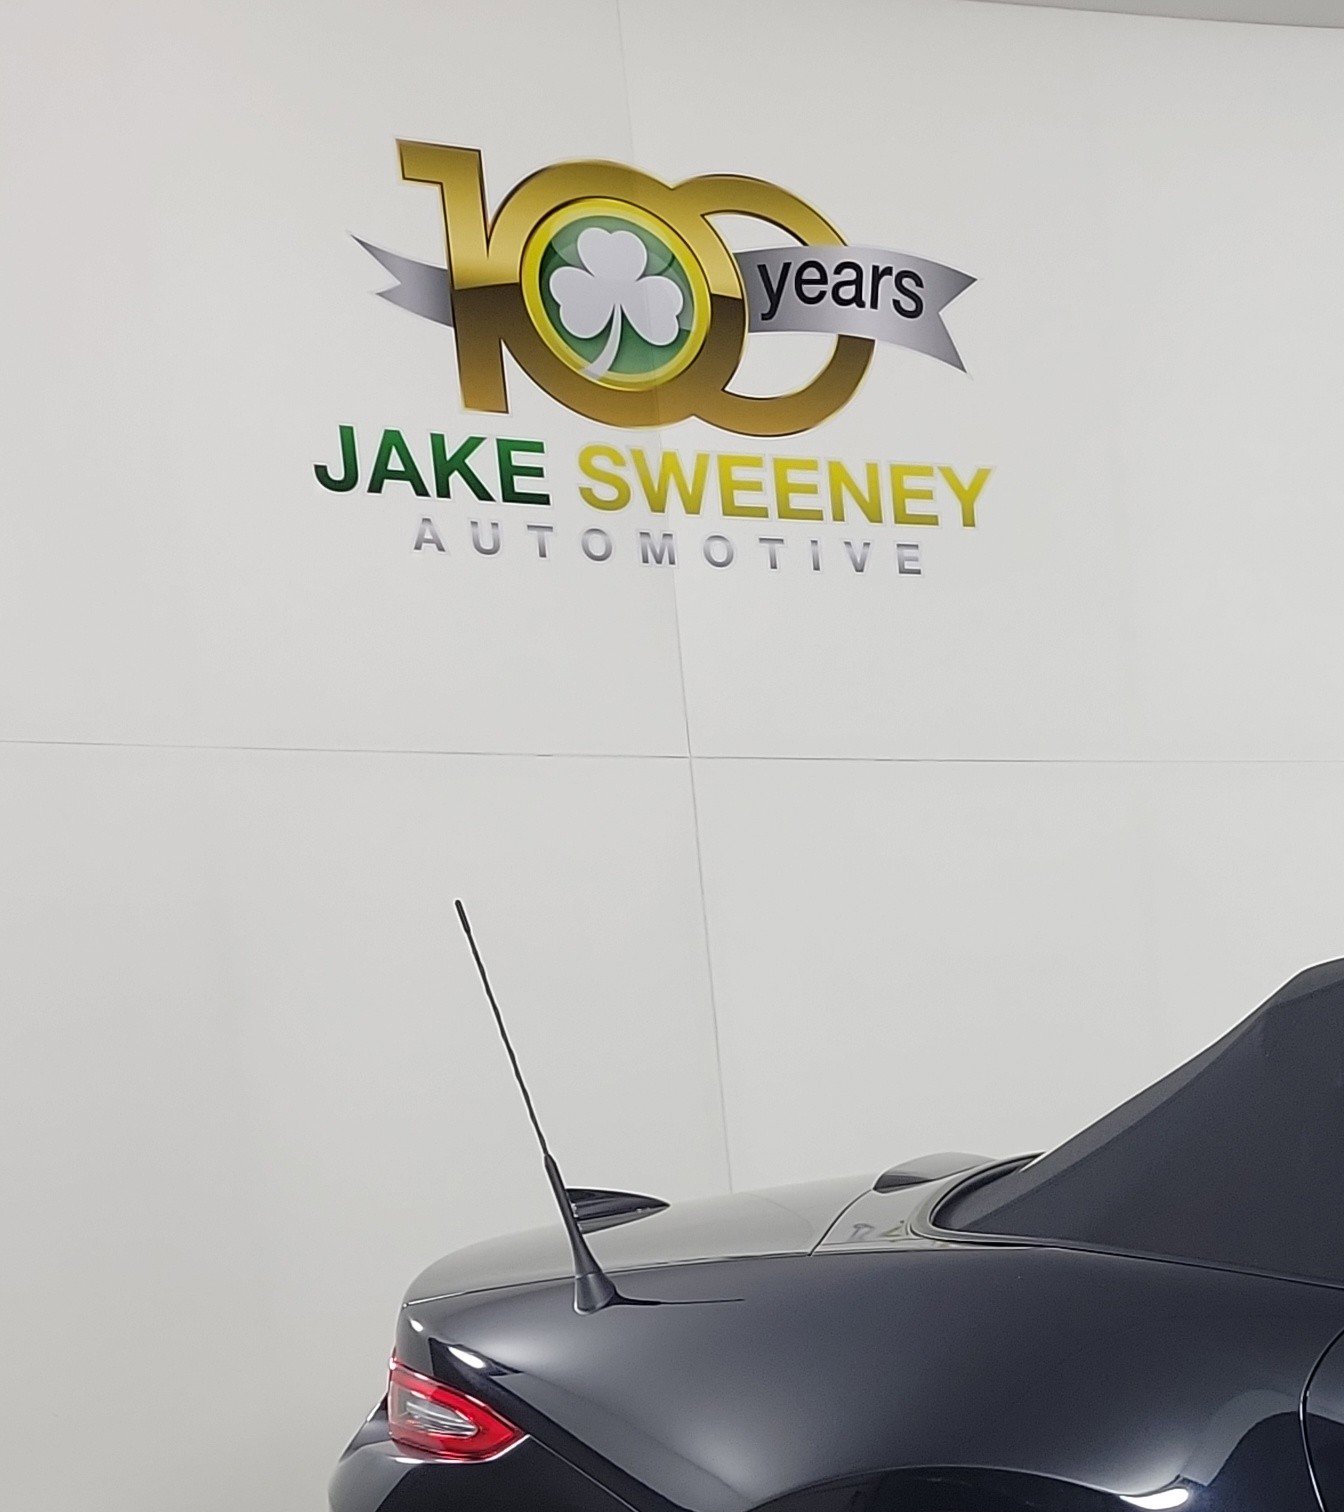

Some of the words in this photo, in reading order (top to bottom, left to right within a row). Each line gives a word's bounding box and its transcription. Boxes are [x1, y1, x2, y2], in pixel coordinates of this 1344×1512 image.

[756, 257, 926, 322] years
[313, 424, 551, 507] JAKE
[577, 443, 992, 529] SWEENEY
[412, 517, 923, 576] AUTOMOTIVE
